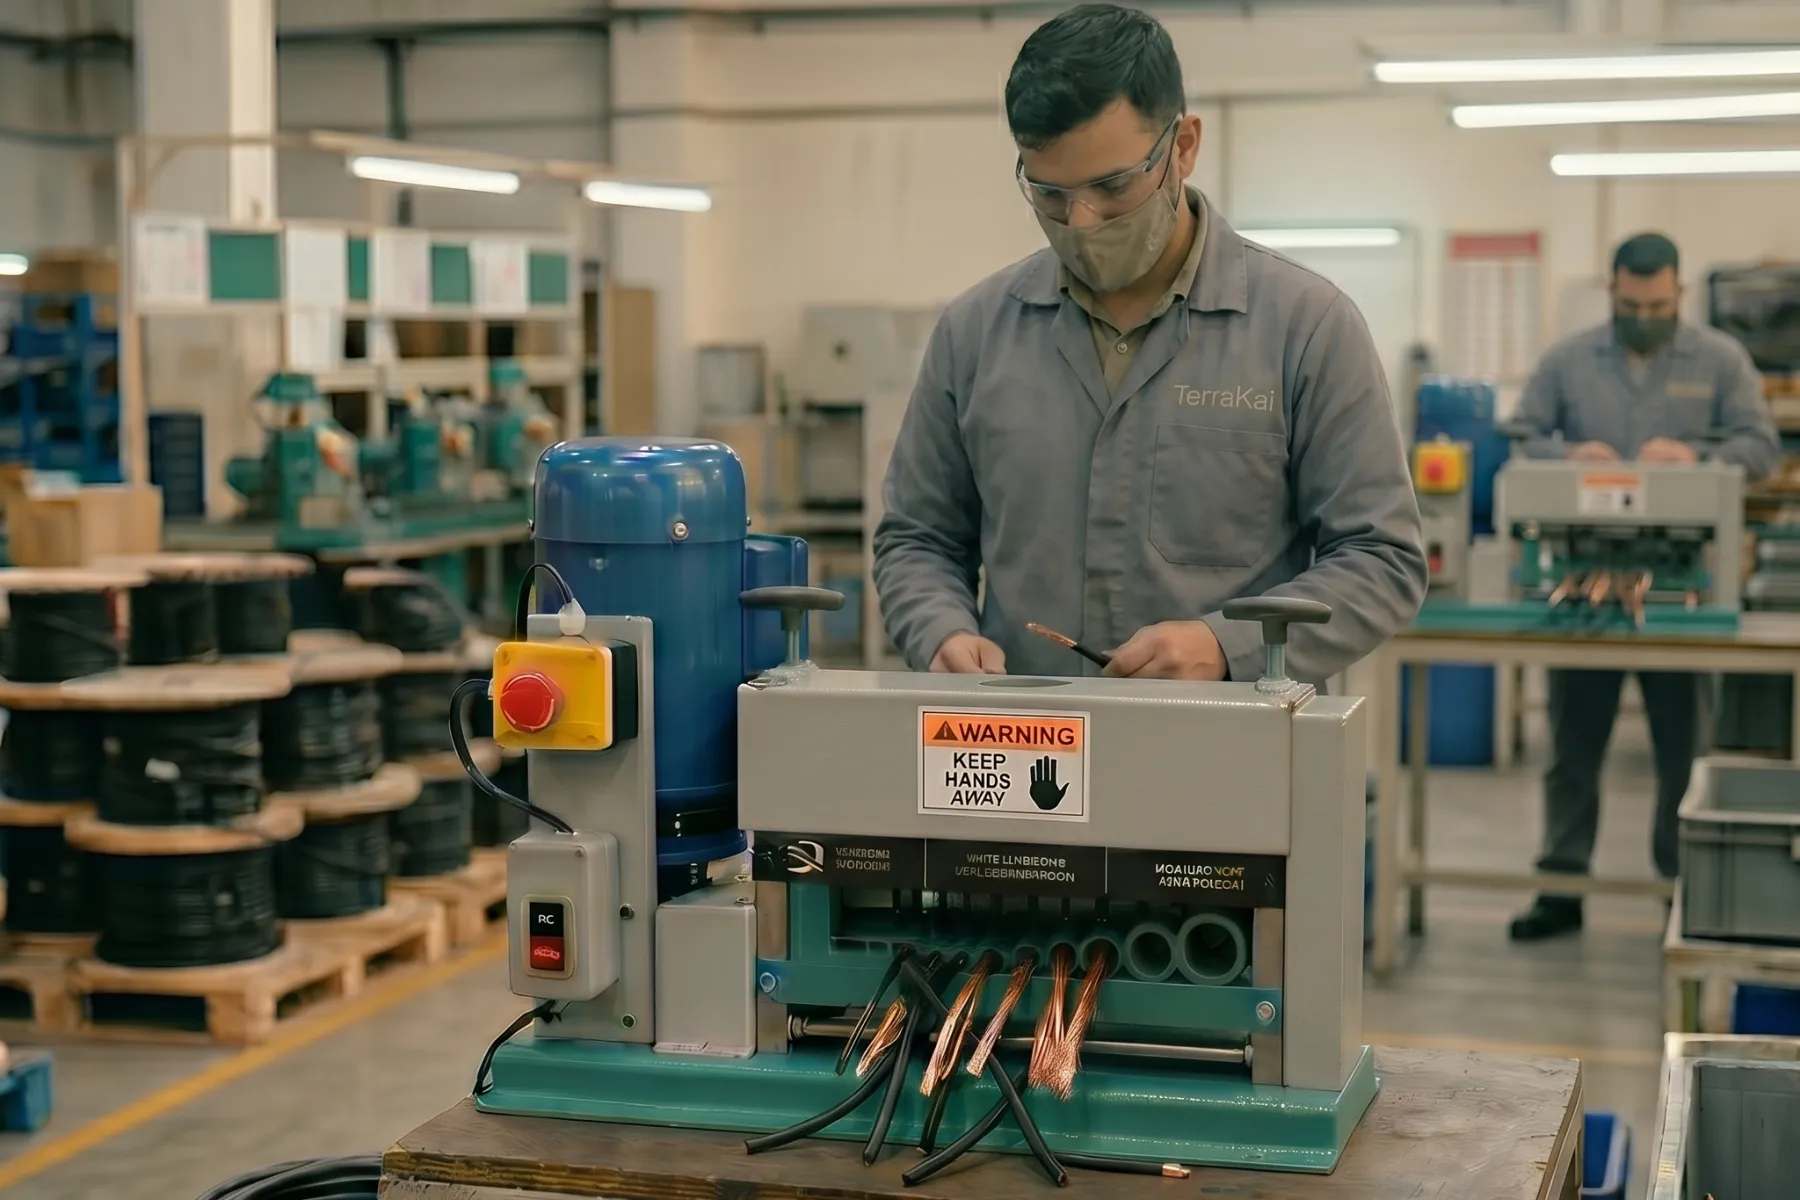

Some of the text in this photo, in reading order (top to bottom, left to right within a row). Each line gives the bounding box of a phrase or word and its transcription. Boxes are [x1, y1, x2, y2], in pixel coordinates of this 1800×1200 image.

[1173, 384, 1275, 412] TerraKai
[958, 723, 1075, 746] WARNING
[953, 752, 1007, 770] KEEP
[945, 771, 1011, 789] HANDS
[950, 790, 1006, 807] AWAY
[966, 853, 1000, 865] WHITE
[538, 914, 555, 925] RC
